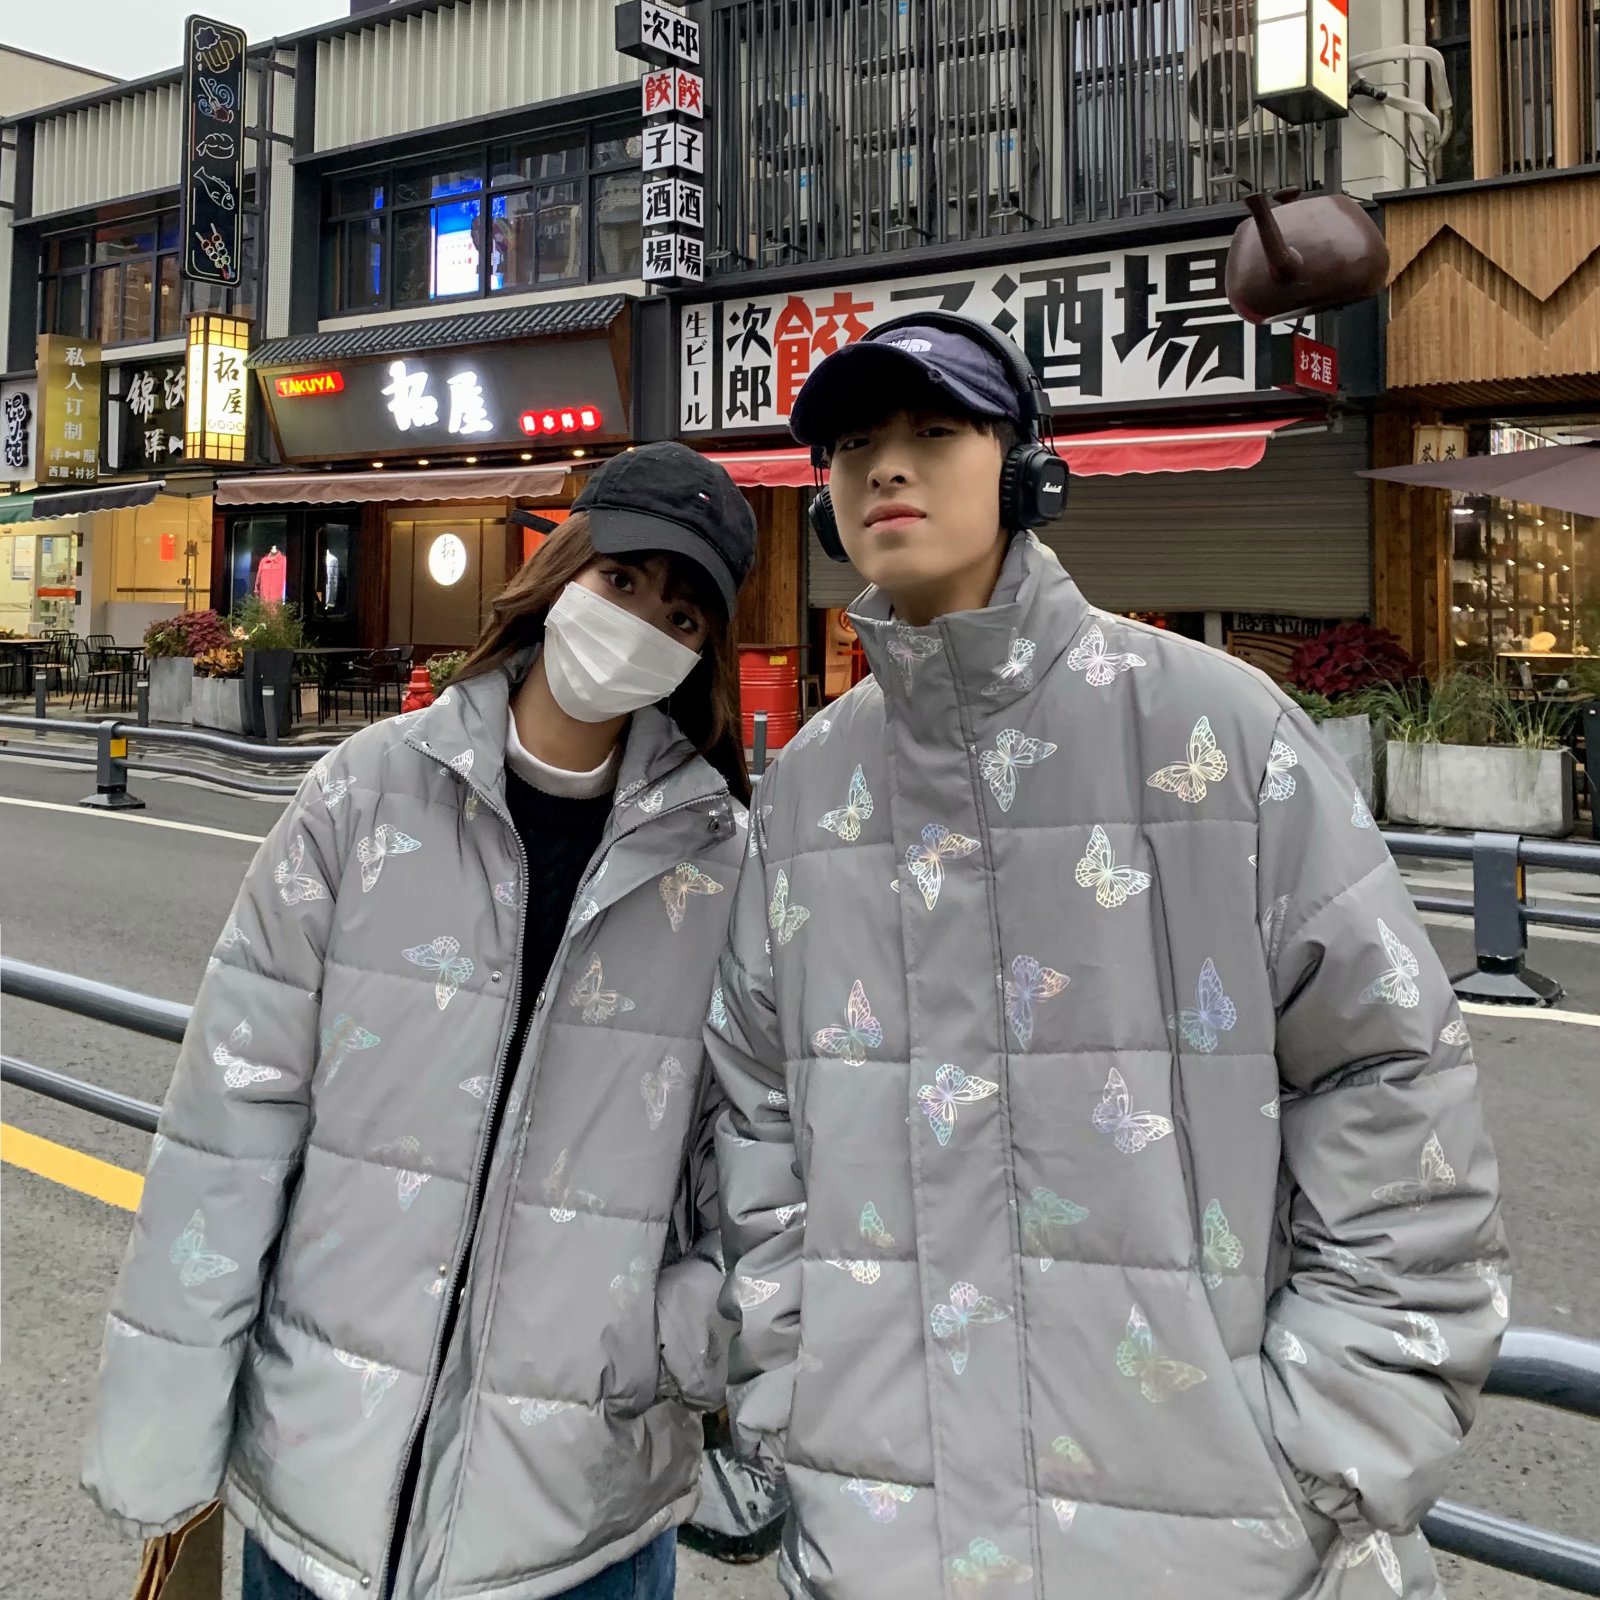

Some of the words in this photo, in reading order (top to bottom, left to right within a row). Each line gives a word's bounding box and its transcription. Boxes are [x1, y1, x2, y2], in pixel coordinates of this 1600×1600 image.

[643, 10, 698, 57] 次郎
[1320, 23, 1342, 73] 2F
[645, 73, 672, 275] 餃子酒場
[677, 73, 701, 277] 餃子酒場
[64, 347, 86, 441] 私人订制
[212, 352, 243, 415] 拓屋
[280, 375, 336, 395] TAKUYA
[381, 361, 493, 433] 拓屋
[685, 311, 708, 425] 生ビール
[726, 302, 772, 421] 次郎
[1300, 350, 1332, 385] お茶屋
